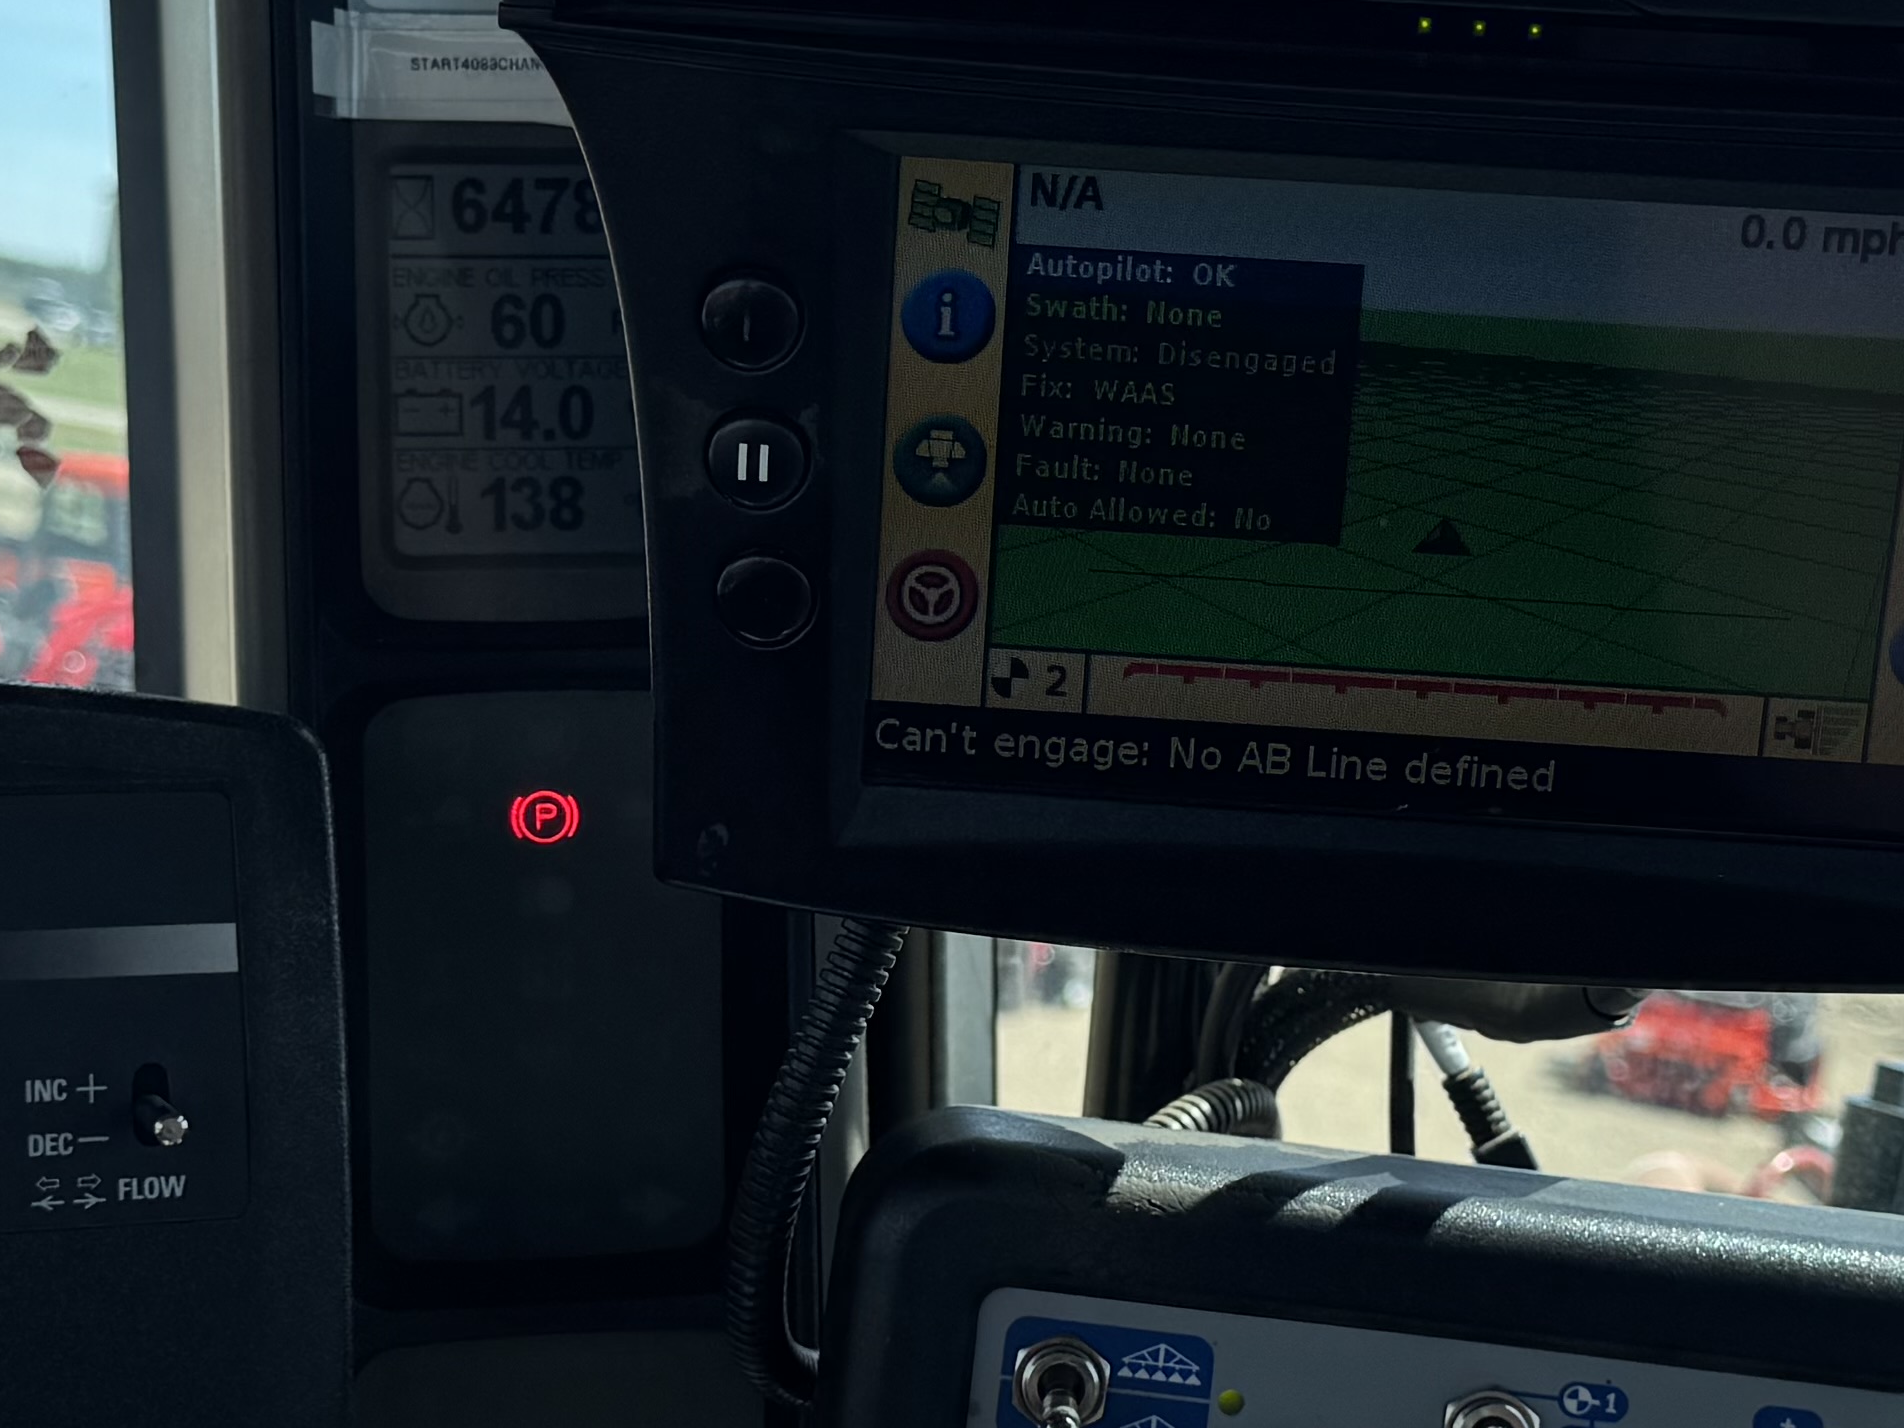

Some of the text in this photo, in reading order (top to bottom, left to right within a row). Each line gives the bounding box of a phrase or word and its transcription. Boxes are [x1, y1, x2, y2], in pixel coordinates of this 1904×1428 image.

[452, 177, 602, 234] 6478
[1029, 173, 1104, 211] N/A
[1740, 214, 1806, 253] 0.0
[1027, 252, 1236, 288] Autopilot: OK
[491, 294, 565, 349] 60
[1025, 293, 1223, 329] Swath: None
[1023, 334, 1336, 377] System: Disengaged
[1021, 373, 1176, 407] Fix: WAAS
[470, 385, 594, 441] 14.0
[1021, 413, 1246, 451] Warning: None
[1016, 453, 1194, 488] Fault: None
[481, 476, 584, 531] 138
[1012, 492, 1272, 532] Auto Allowed: No
[1045, 665, 1069, 698] 2
[875, 717, 1555, 793] Can't engage: No AB Line defined
[25, 1077, 69, 1104] INC
[27, 1132, 75, 1159] DEC
[117, 1174, 188, 1202] FLOW
[1605, 1392, 1618, 1415] 1
